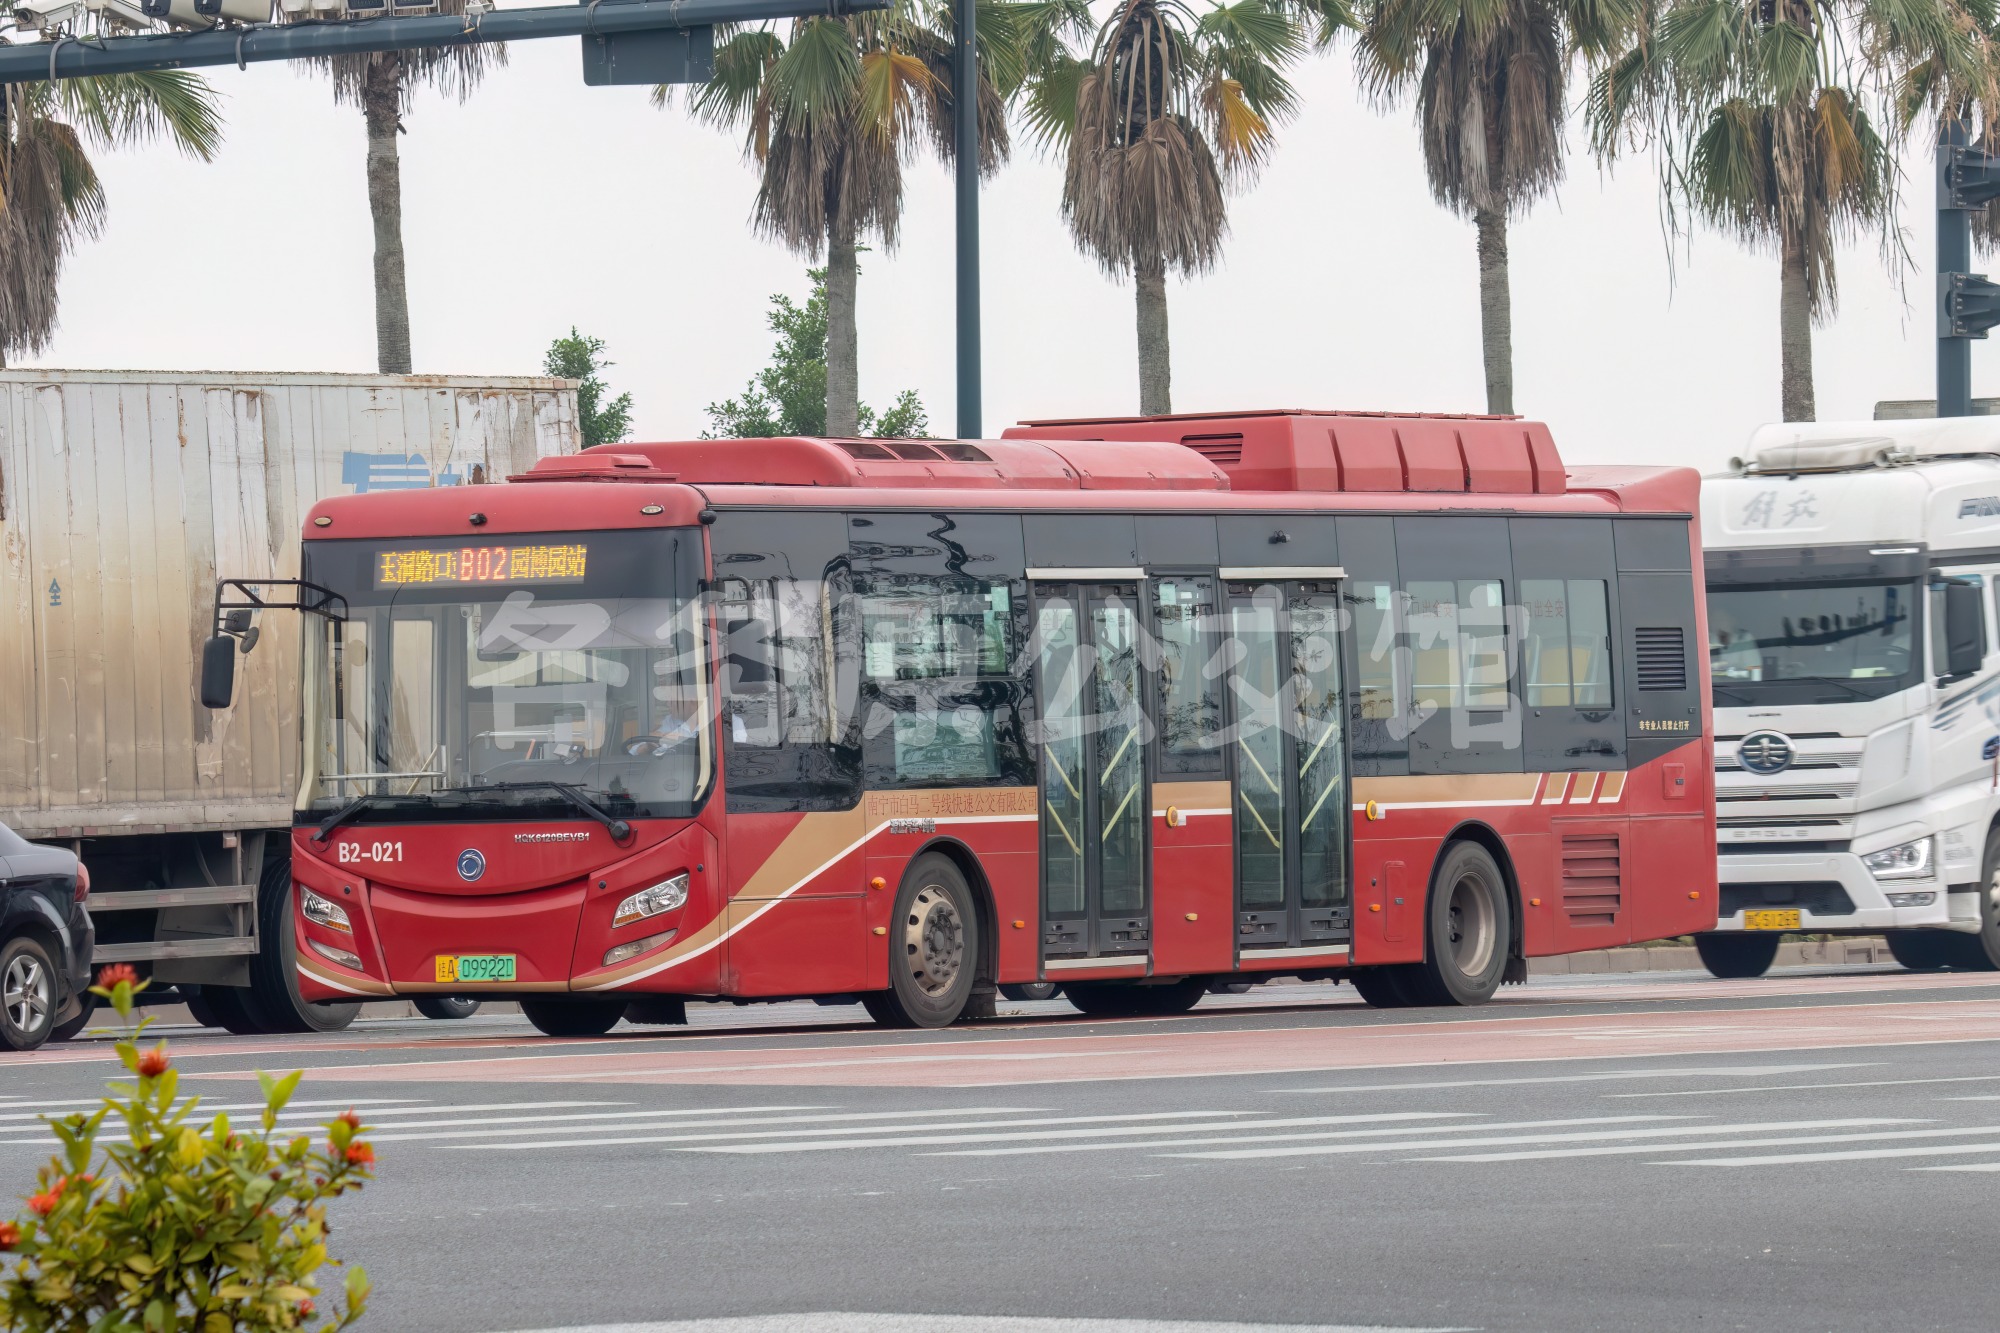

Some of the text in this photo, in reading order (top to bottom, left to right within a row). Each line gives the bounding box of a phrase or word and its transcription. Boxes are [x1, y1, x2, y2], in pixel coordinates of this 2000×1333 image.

[460, 547, 507, 581] B02
[867, 791, 1038, 816] 南宁市白马二号线快速公交有限公司
[338, 841, 403, 863] B2-021
